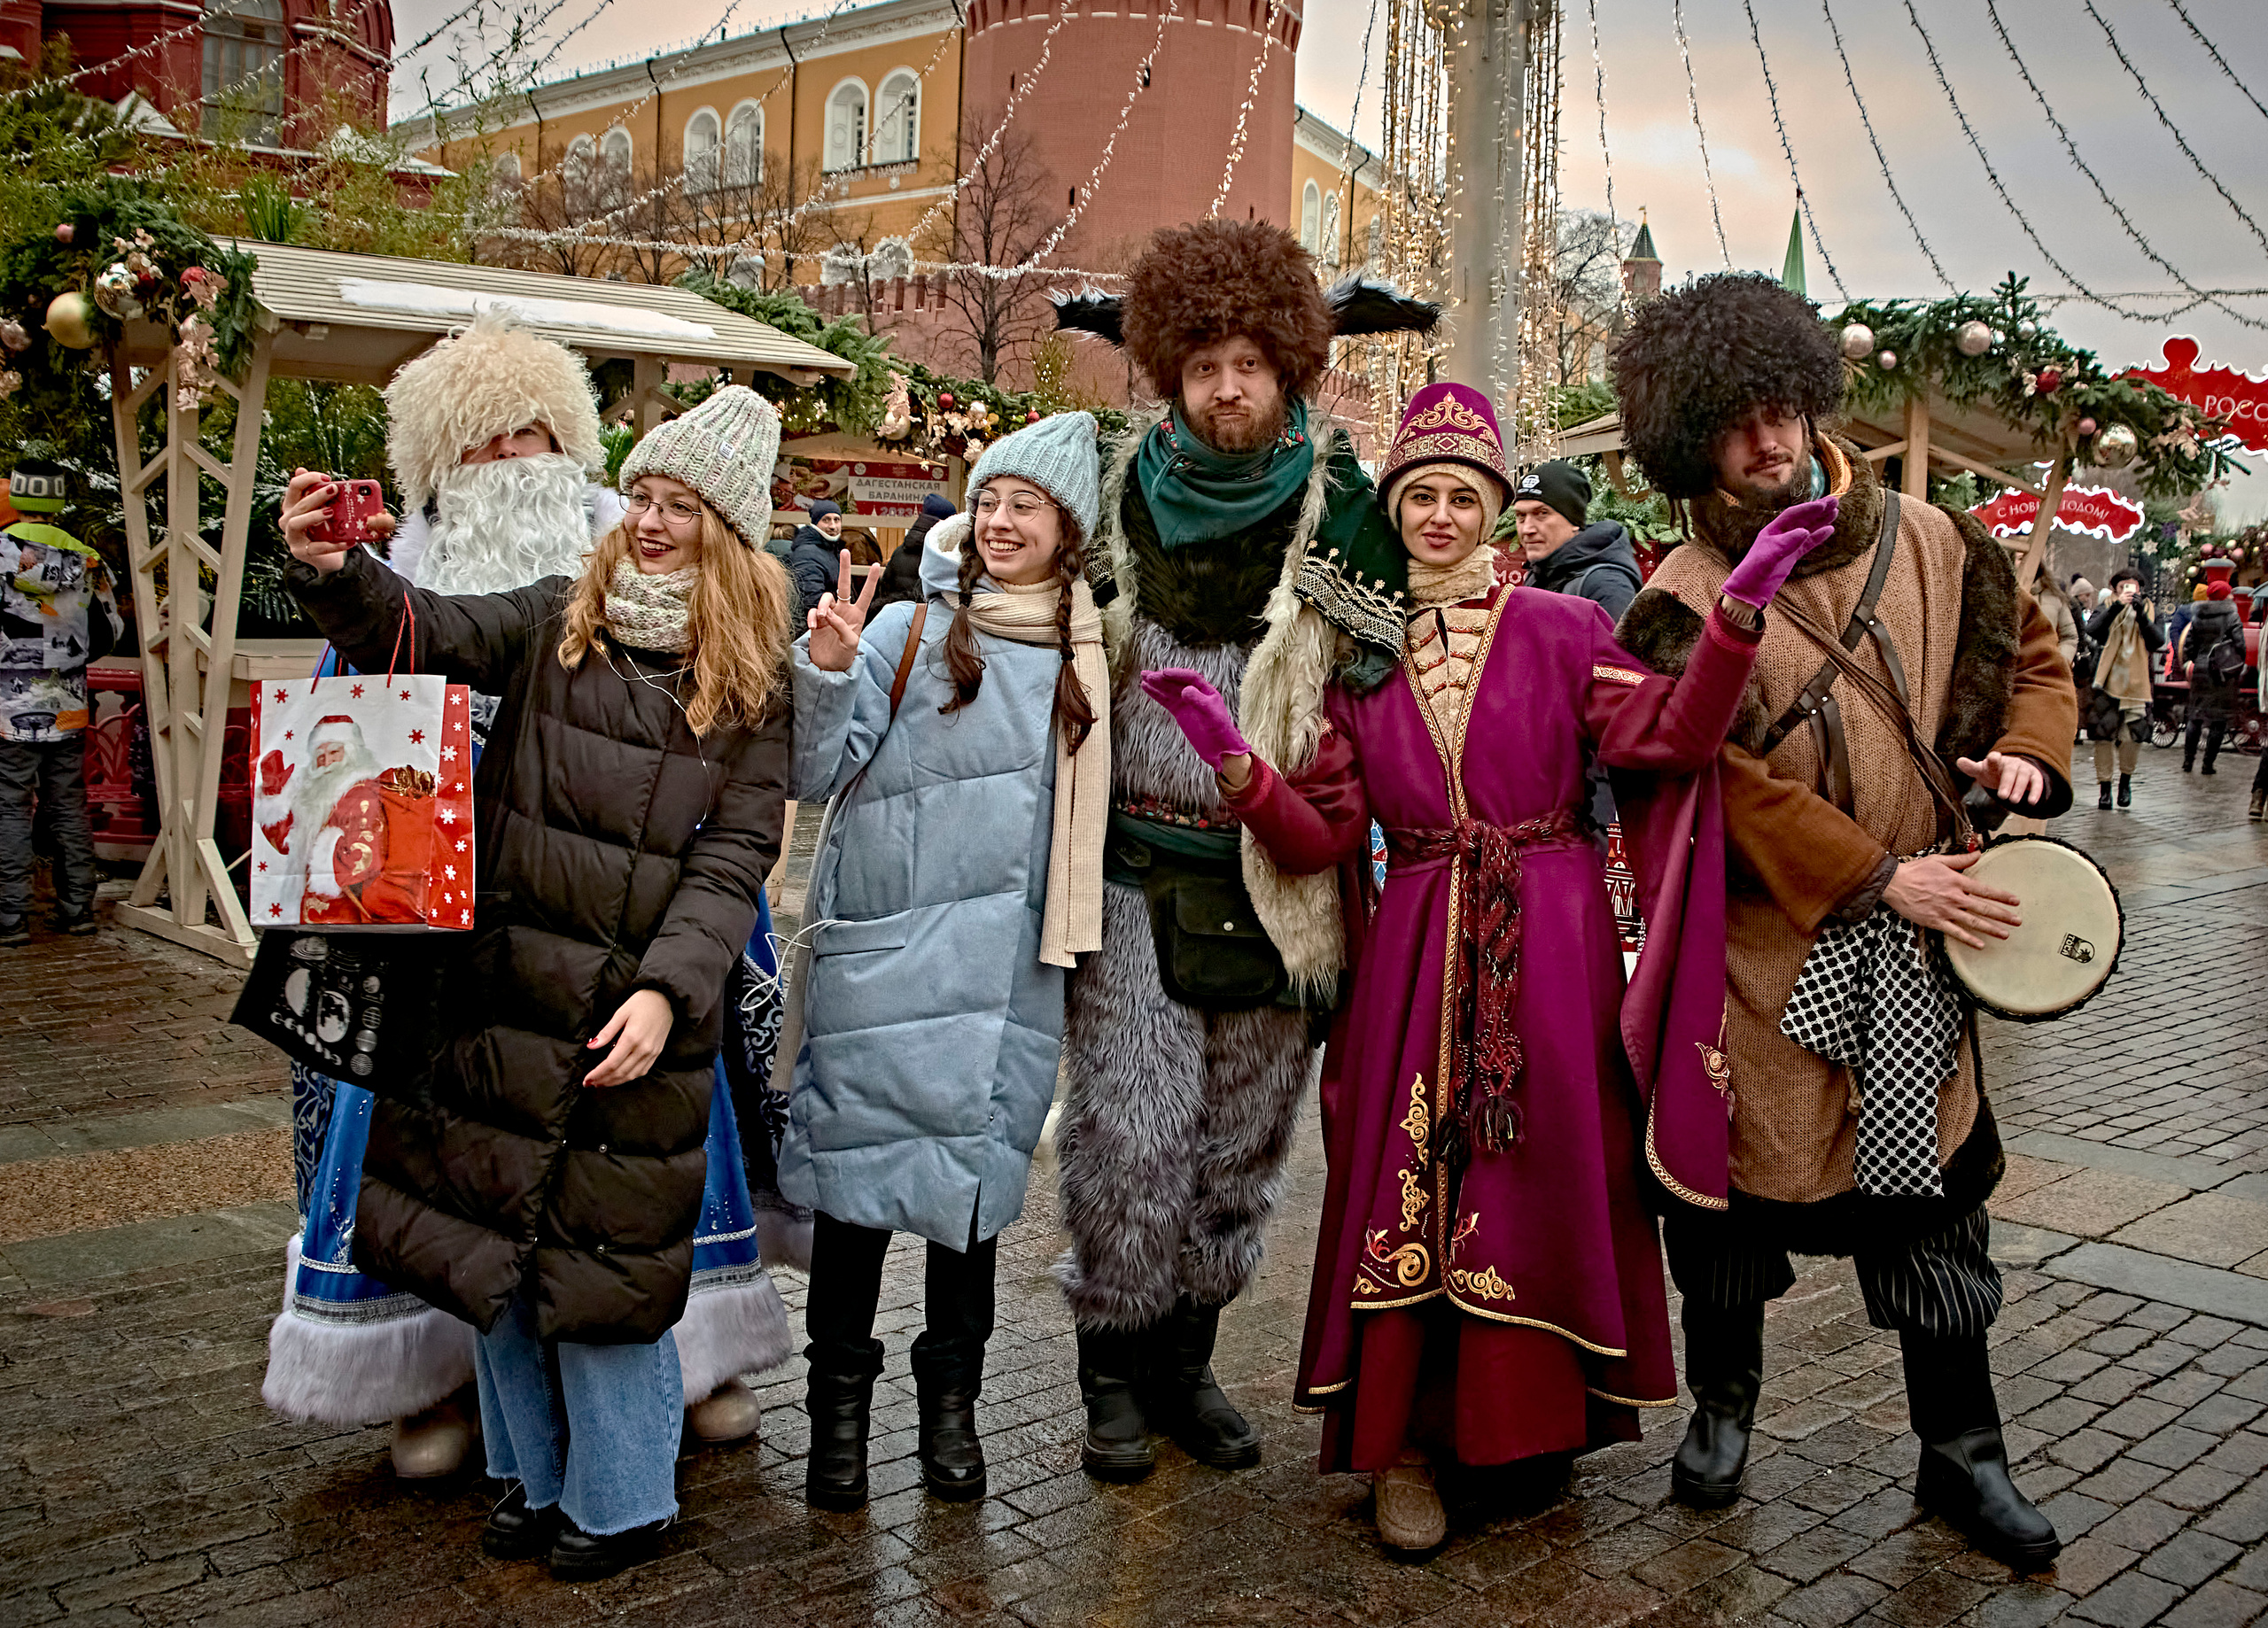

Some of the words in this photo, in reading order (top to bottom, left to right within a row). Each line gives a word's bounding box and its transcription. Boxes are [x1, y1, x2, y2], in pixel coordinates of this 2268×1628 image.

[856, 478, 940, 490] ДАГЕСТАНСКАЯ
[1997, 507, 2007, 518] С
[2009, 501, 2039, 516] НОВ
[2062, 500, 2109, 521] ГОДОМ!
[2062, 935, 2075, 955] TOCA
